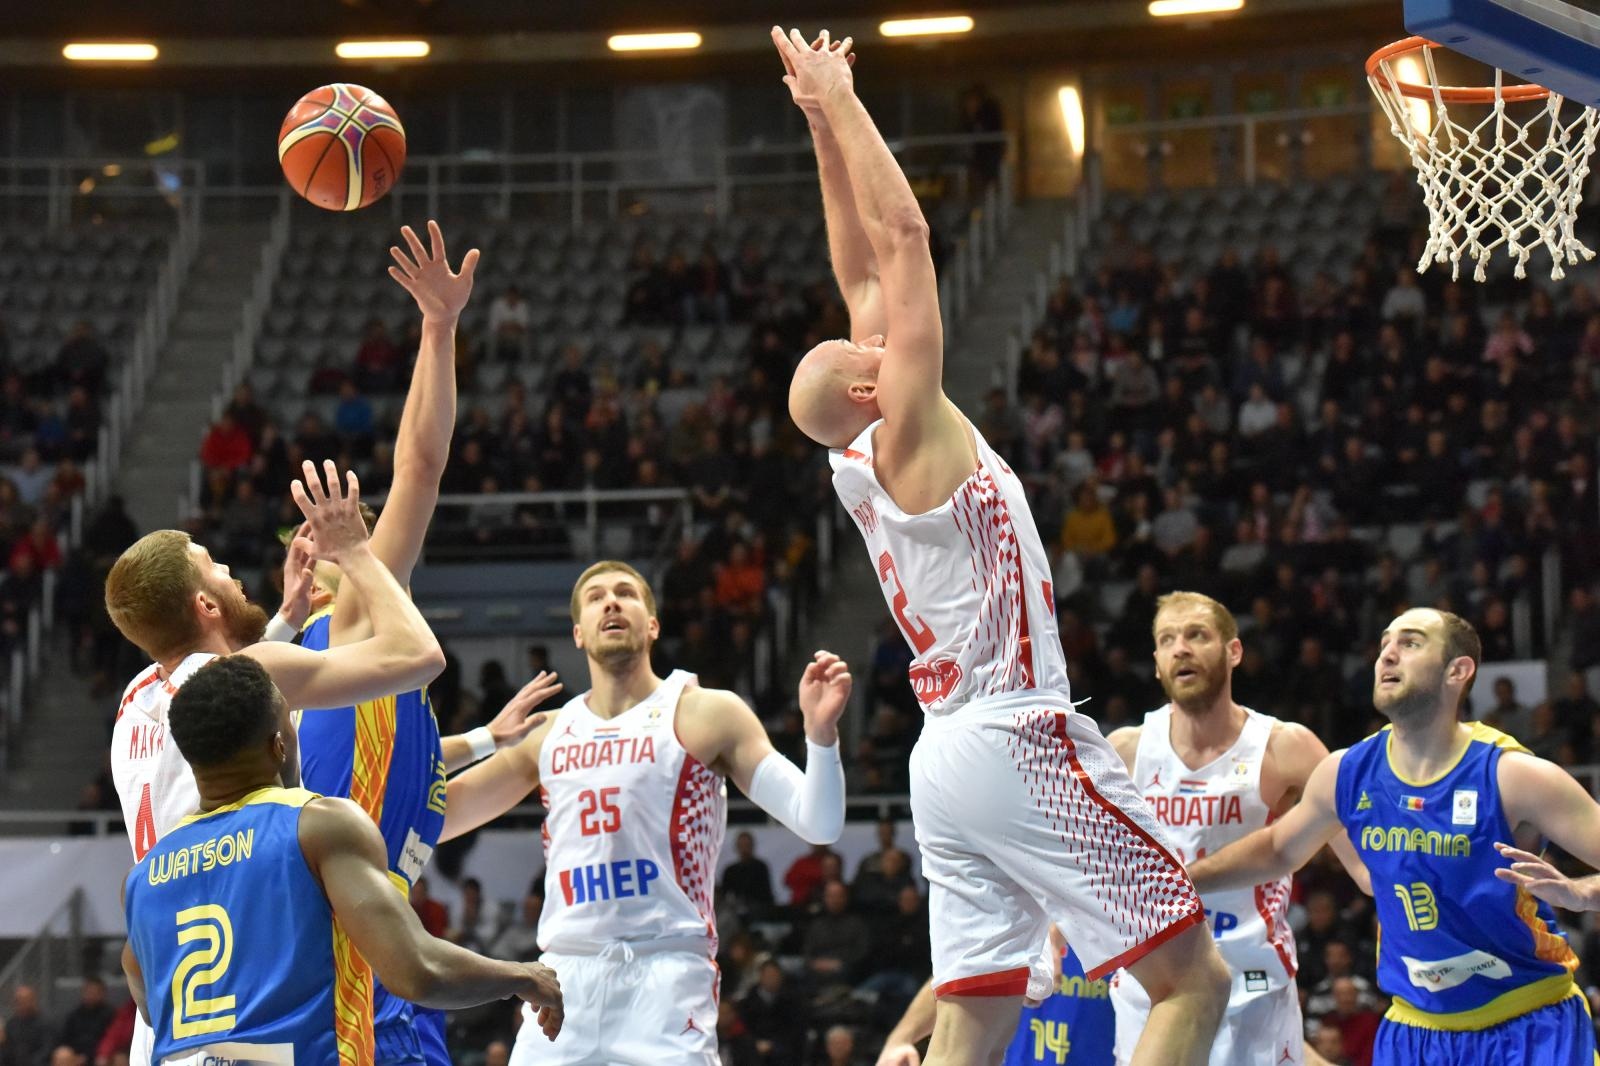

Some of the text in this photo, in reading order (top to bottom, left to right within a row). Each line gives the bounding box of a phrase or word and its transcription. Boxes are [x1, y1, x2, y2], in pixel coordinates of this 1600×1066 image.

[879, 550, 937, 655] 2
[551, 736, 656, 775] CROATIA
[578, 787, 621, 836] 25
[148, 829, 255, 886] WATSON
[1361, 826, 1471, 857] ROMANIA
[1394, 882, 1439, 931] 13
[171, 903, 237, 1040] 2
[1060, 974, 1109, 998] ANIA
[1030, 1018, 1070, 1065] 14
